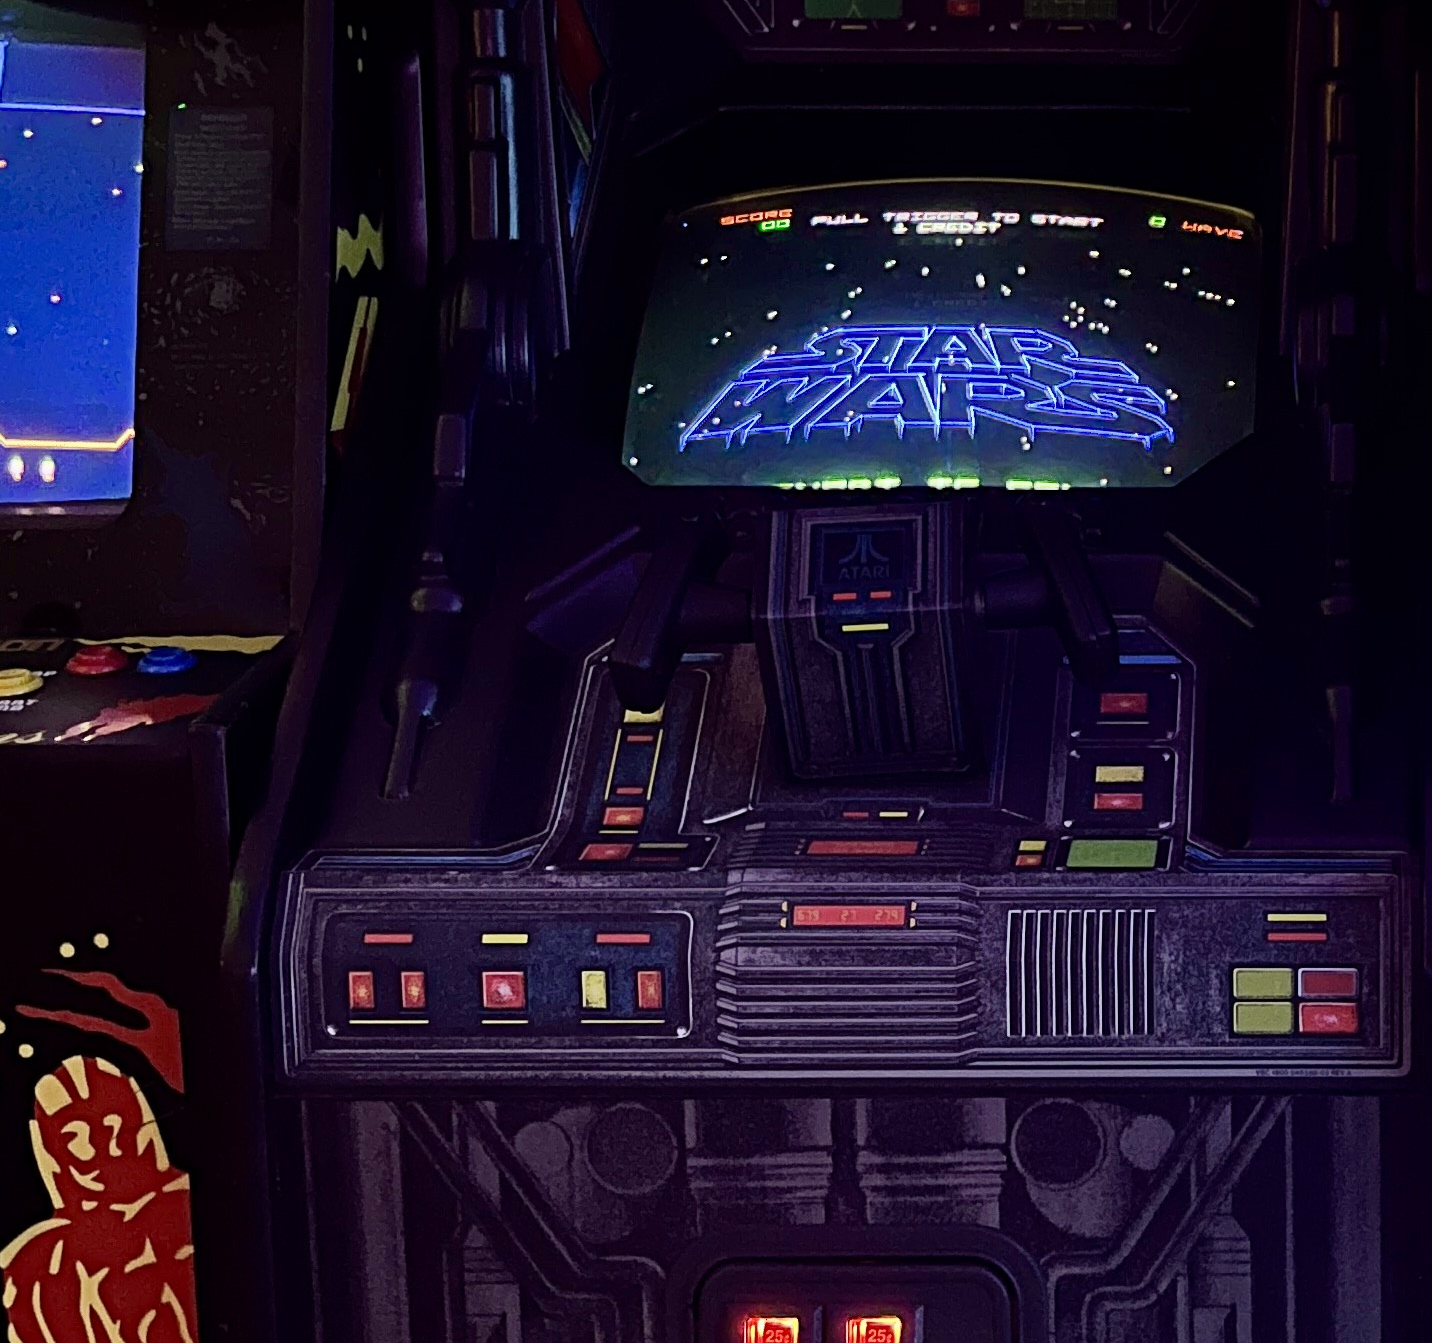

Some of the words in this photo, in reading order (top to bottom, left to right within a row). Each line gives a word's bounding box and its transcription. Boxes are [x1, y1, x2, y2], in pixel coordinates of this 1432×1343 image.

[720, 208, 793, 226] SCORE
[811, 213, 870, 226] PULL
[883, 211, 978, 223] TRIGGER
[992, 212, 1021, 225] TO
[1031, 213, 1104, 228] START
[916, 221, 1001, 234] CREDIT
[1182, 220, 1245, 240] WAVE
[741, 322, 1141, 383] STAR
[678, 371, 1175, 452] WARS
[839, 564, 890, 581] ATARI
[766, 1329, 790, 1343] 25¢
[868, 1328, 892, 1343] 25¢
